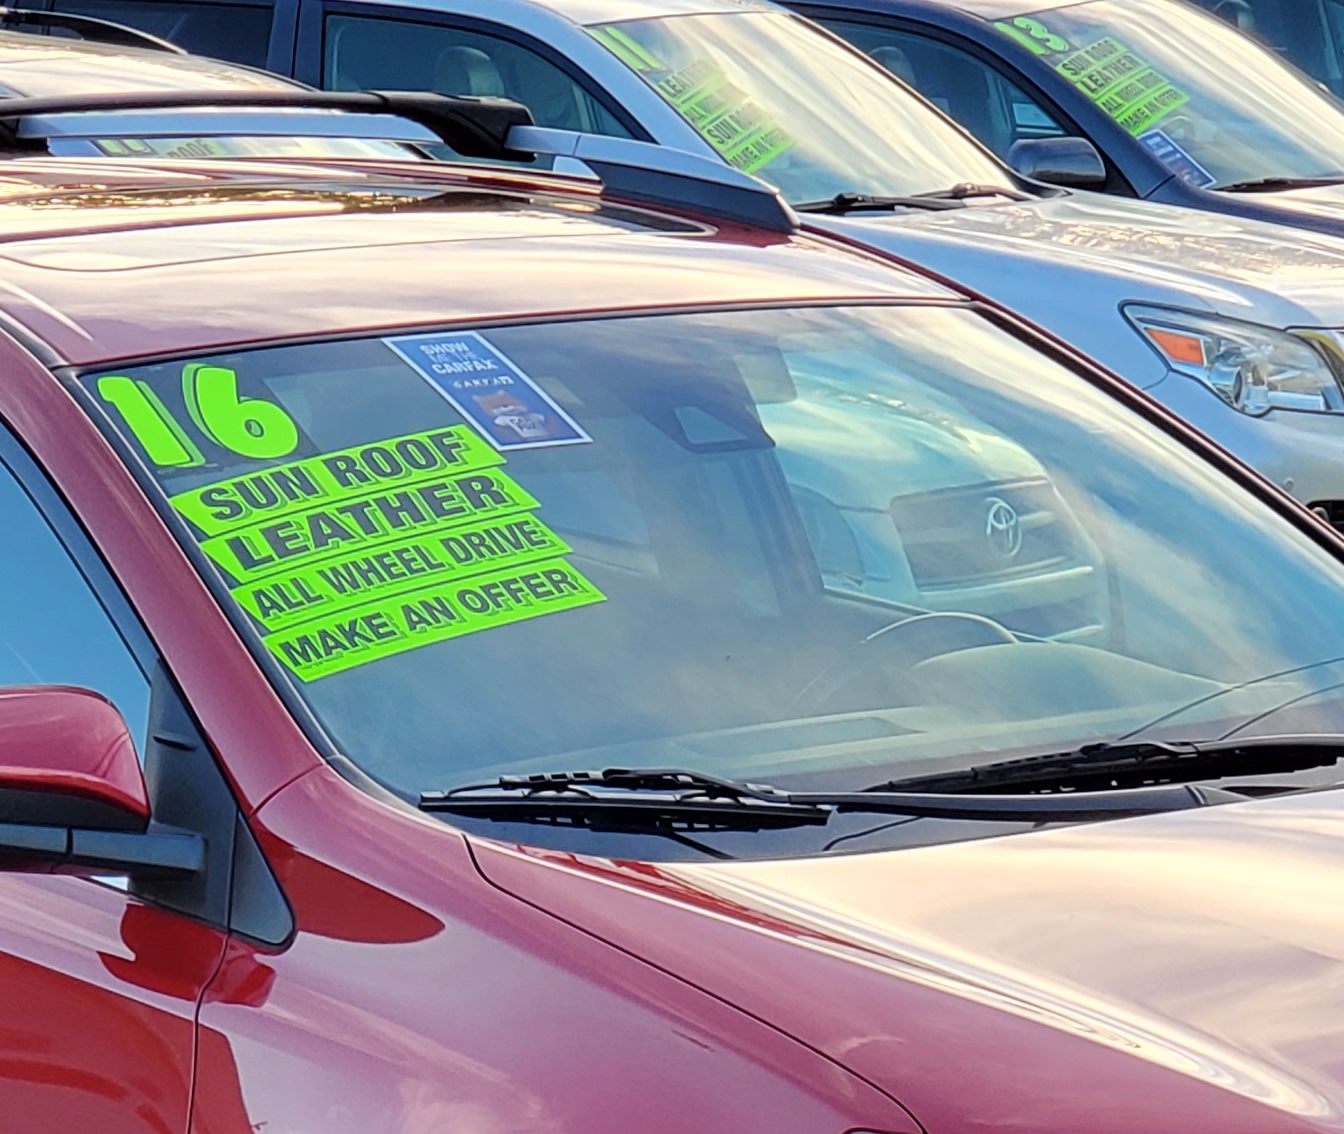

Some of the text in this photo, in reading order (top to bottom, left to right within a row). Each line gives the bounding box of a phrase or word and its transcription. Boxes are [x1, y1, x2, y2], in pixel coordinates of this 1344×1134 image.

[1061, 53, 1093, 76] SUN
[1080, 53, 1144, 94] LEATHER
[419, 341, 470, 356] SHOW
[431, 357, 500, 375] CARFAX
[97, 362, 300, 469] 16
[200, 431, 466, 521] SUN ROOF
[225, 475, 510, 571] LEATHER
[251, 519, 549, 620] ALL WHEEL DRIVE
[277, 568, 580, 668] MAKE AN OFFER
